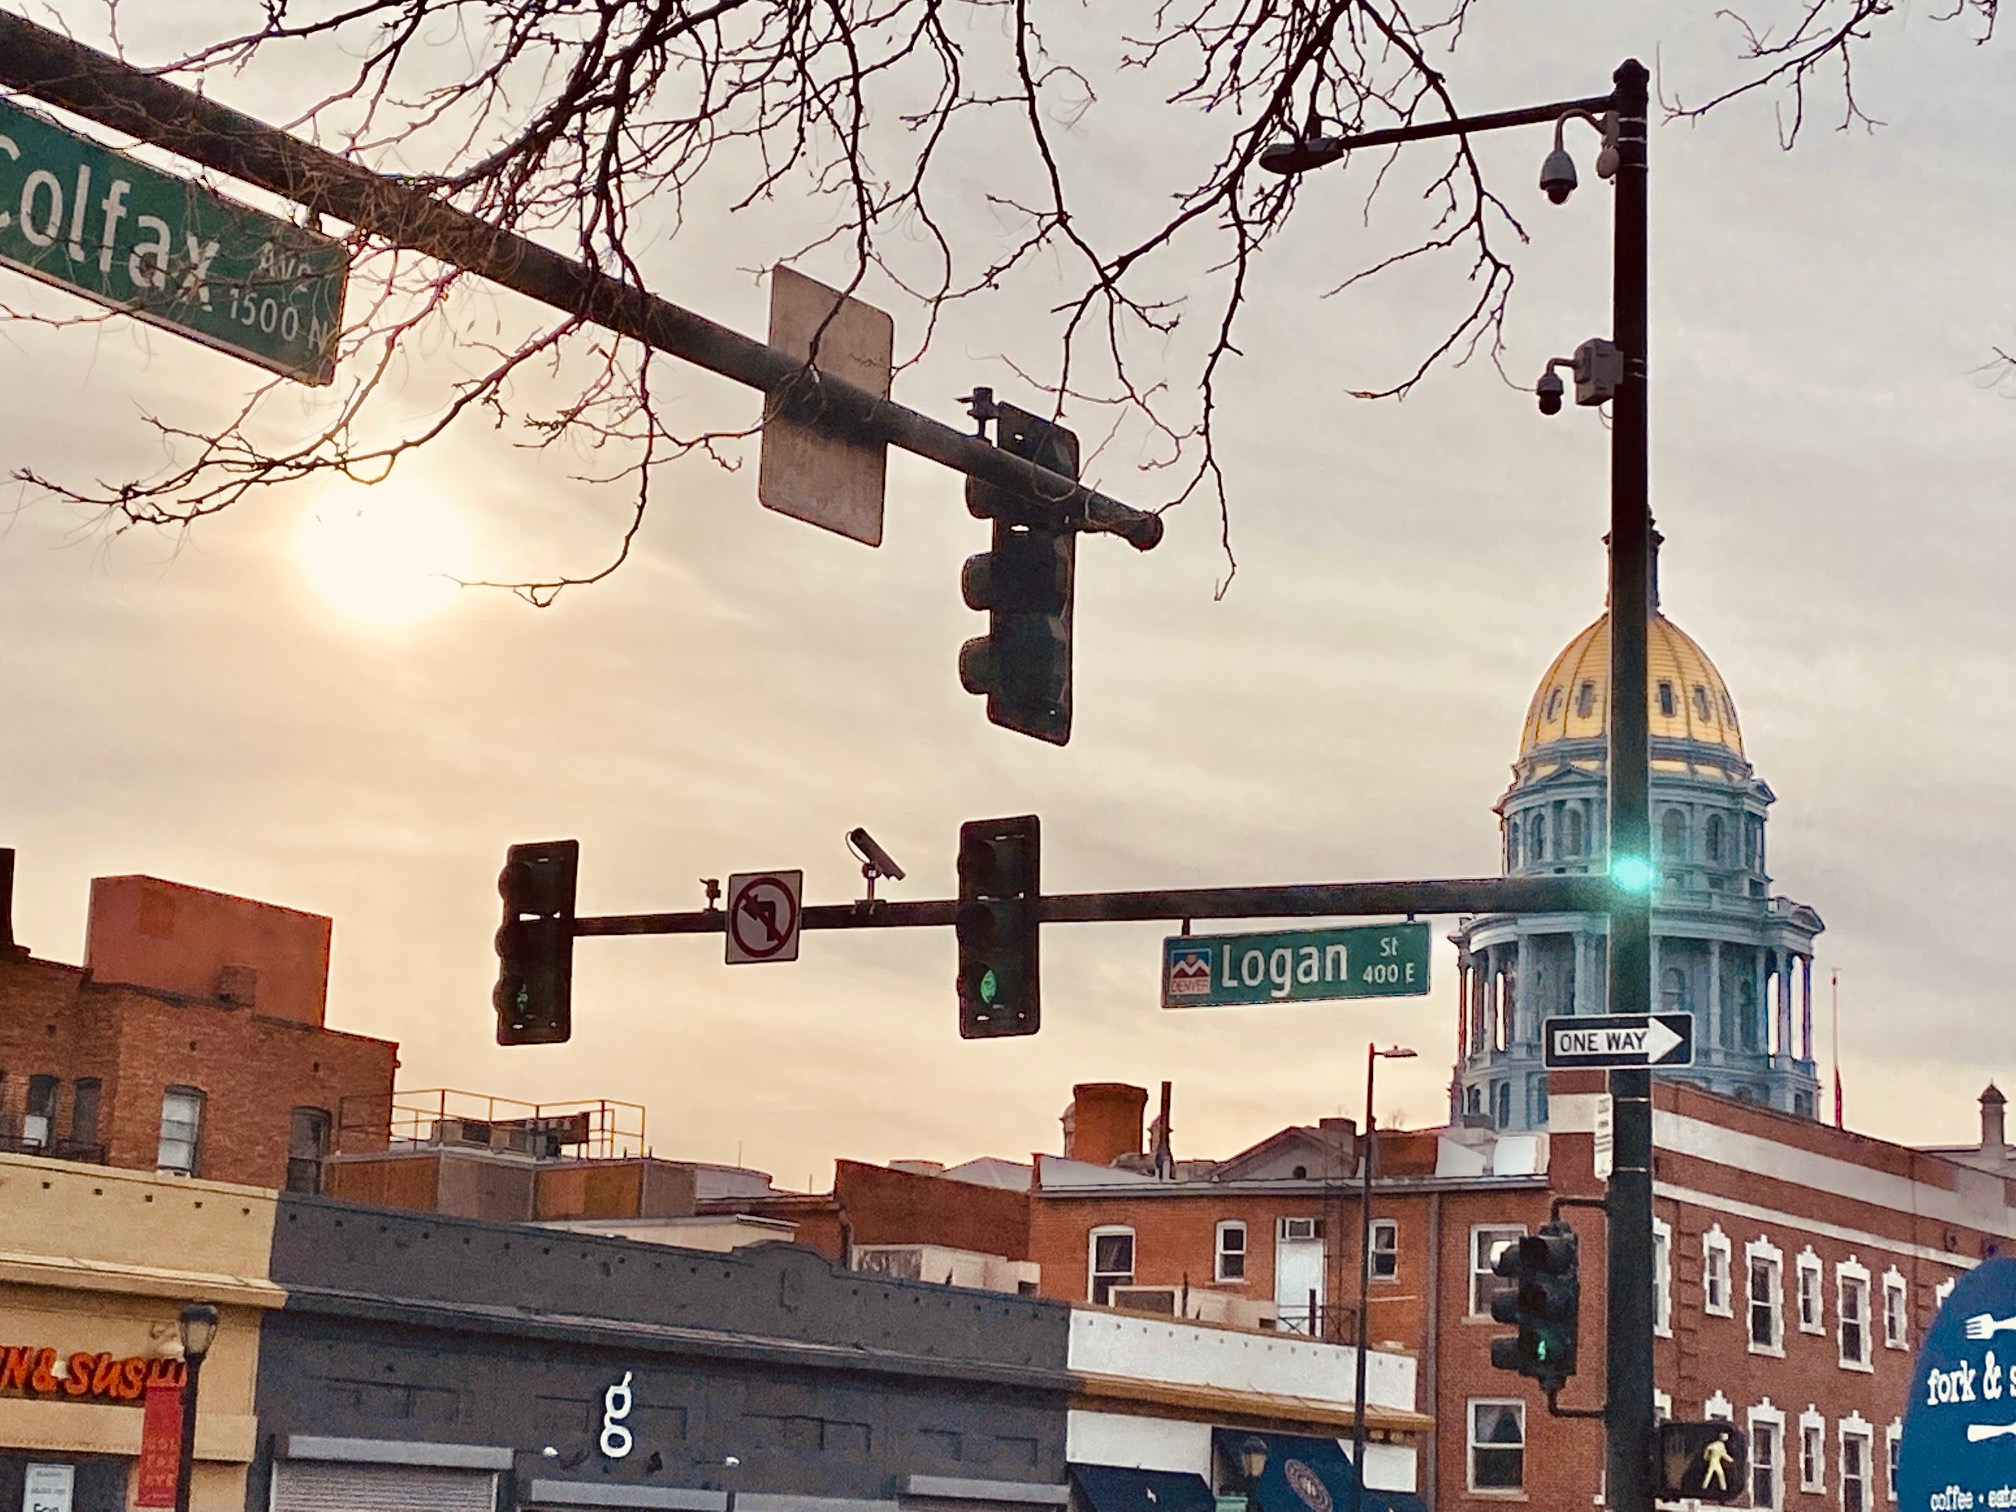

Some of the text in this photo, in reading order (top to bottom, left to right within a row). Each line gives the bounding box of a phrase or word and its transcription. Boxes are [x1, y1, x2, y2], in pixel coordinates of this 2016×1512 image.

[229, 287, 299, 342] 1500
[1380, 936, 1397, 957] St
[1221, 944, 1348, 998] Logan
[1362, 962, 1415, 985] 400 E
[1560, 1031, 1647, 1052] ONE WAY
[1927, 1359, 1976, 1406] fork
[1983, 1350, 2003, 1400] &
[600, 1370, 633, 1458] g
[1930, 1484, 1974, 1511] coffee
